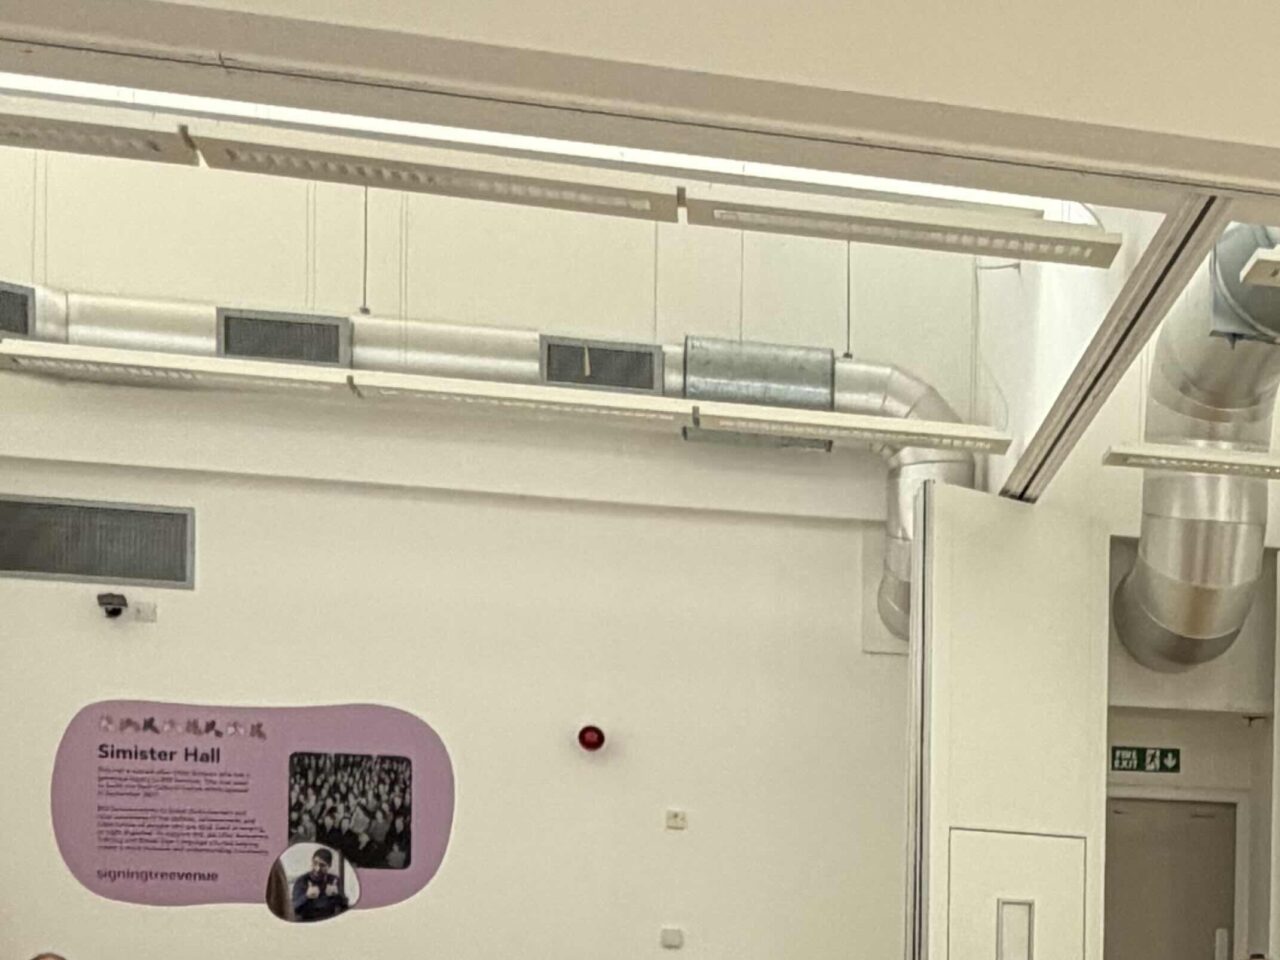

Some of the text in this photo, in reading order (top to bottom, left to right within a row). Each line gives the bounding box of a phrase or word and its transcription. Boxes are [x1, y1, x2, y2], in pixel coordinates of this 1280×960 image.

[98, 743, 221, 764] Simister Hall
[1114, 759, 1138, 769] EXIT
[96, 868, 219, 883] signingtreevenue
